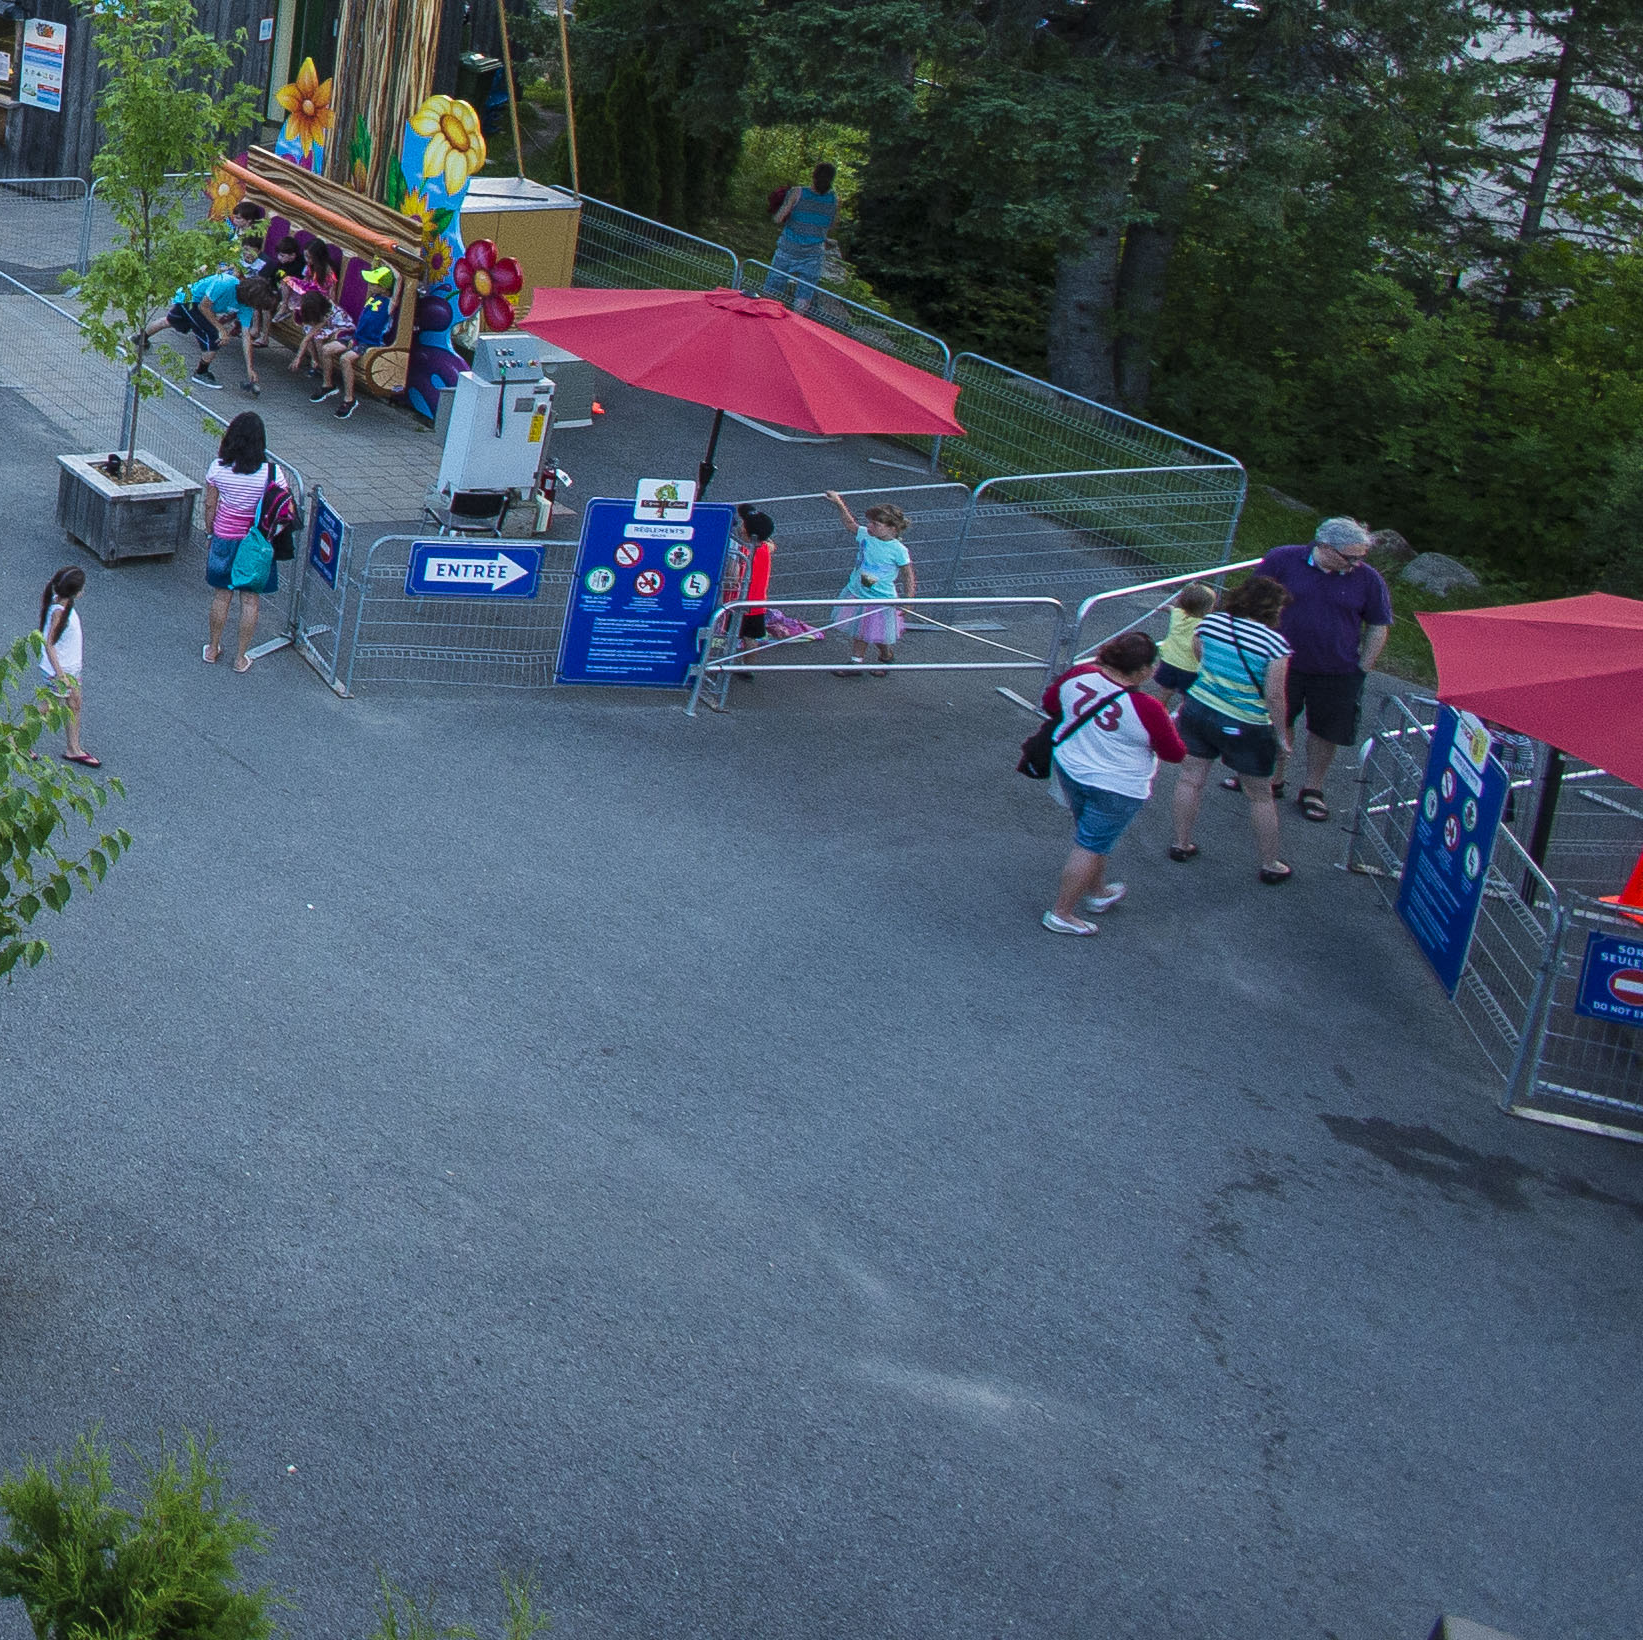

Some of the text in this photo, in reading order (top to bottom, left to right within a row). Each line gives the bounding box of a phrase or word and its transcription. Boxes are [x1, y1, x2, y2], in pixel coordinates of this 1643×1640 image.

[436, 561, 508, 579] ENTRÉE
[1072, 681, 1123, 732] 73
[1593, 1001, 1608, 1011] DO
[1610, 1005, 1633, 1016] NOT
